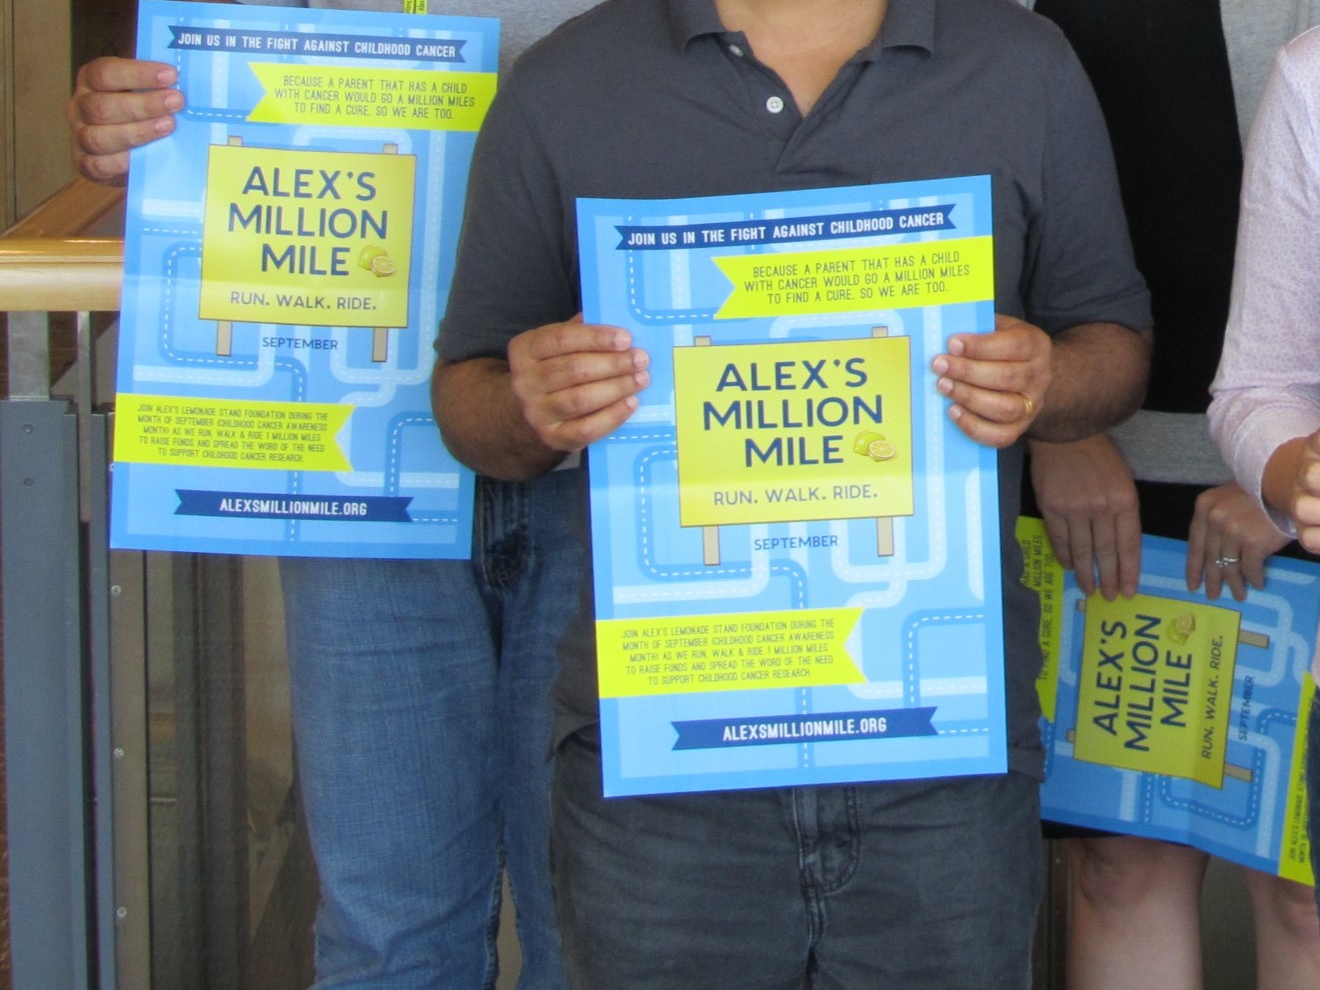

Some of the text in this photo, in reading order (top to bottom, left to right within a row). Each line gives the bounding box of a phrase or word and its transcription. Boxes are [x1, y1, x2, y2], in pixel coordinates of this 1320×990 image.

[177, 33, 455, 57] JOIN US IN THE FIGHT AGAINST CHILDHOOD CANCER
[241, 165, 376, 201] ALEX'S
[228, 202, 388, 239] MILLION
[627, 212, 944, 244] JOIN US IN THE FIGHT AGAINST CHILDHOOD CANCER
[261, 243, 350, 276] MILE
[752, 250, 959, 277] BECAUSE A PARENT THAT HAS A CHILD
[743, 264, 969, 291] WITH CANCER WOULD GO A MILLION MILES
[766, 293, 781, 304] TO
[785, 291, 809, 303] FIND
[814, 290, 821, 301] A
[859, 287, 873, 298] SO
[877, 285, 895, 297] WE
[900, 283, 919, 295] ARE
[230, 291, 376, 310] RUN. WALK. RIDE.
[262, 337, 338, 351] SEPTEMBER
[715, 357, 867, 391] ALEX'S
[702, 394, 882, 430] MILLION
[744, 435, 843, 467] MILE
[219, 498, 367, 515] ALEXSMILLIONMILE.ORG
[713, 484, 877, 505] RUN. WALK. RIDE.
[753, 535, 838, 550] SEPTEMBER
[1092, 620, 1127, 735] ALEX'S
[1123, 614, 1161, 751] MILLION
[1159, 649, 1192, 727] MILE
[1200, 635, 1222, 759] RUN. WALK. RIDE.
[1237, 676, 1257, 740] SEPTEMBER
[722, 717, 886, 740] ALEXSMILLIONMILE.ORG
